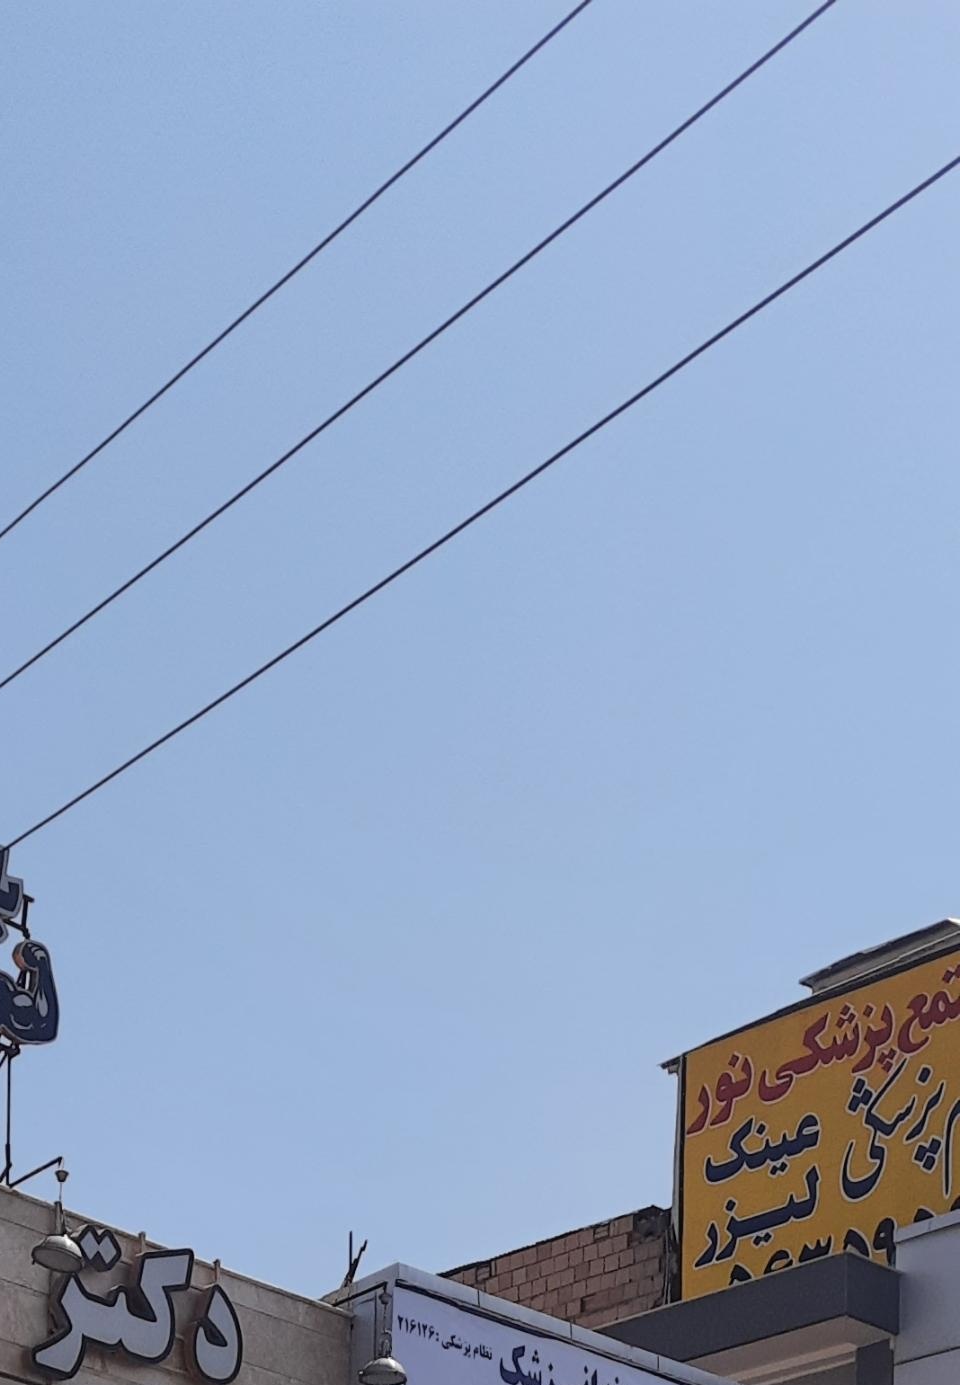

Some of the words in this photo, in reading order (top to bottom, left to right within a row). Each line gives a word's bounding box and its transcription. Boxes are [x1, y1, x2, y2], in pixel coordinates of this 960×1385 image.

[686, 1052, 753, 1137] نور
[758, 1003, 897, 1103] پزشکی
[704, 1112, 821, 1183] عینک
[841, 1058, 945, 1202] پزشکی
[693, 1164, 821, 1269] لیزر
